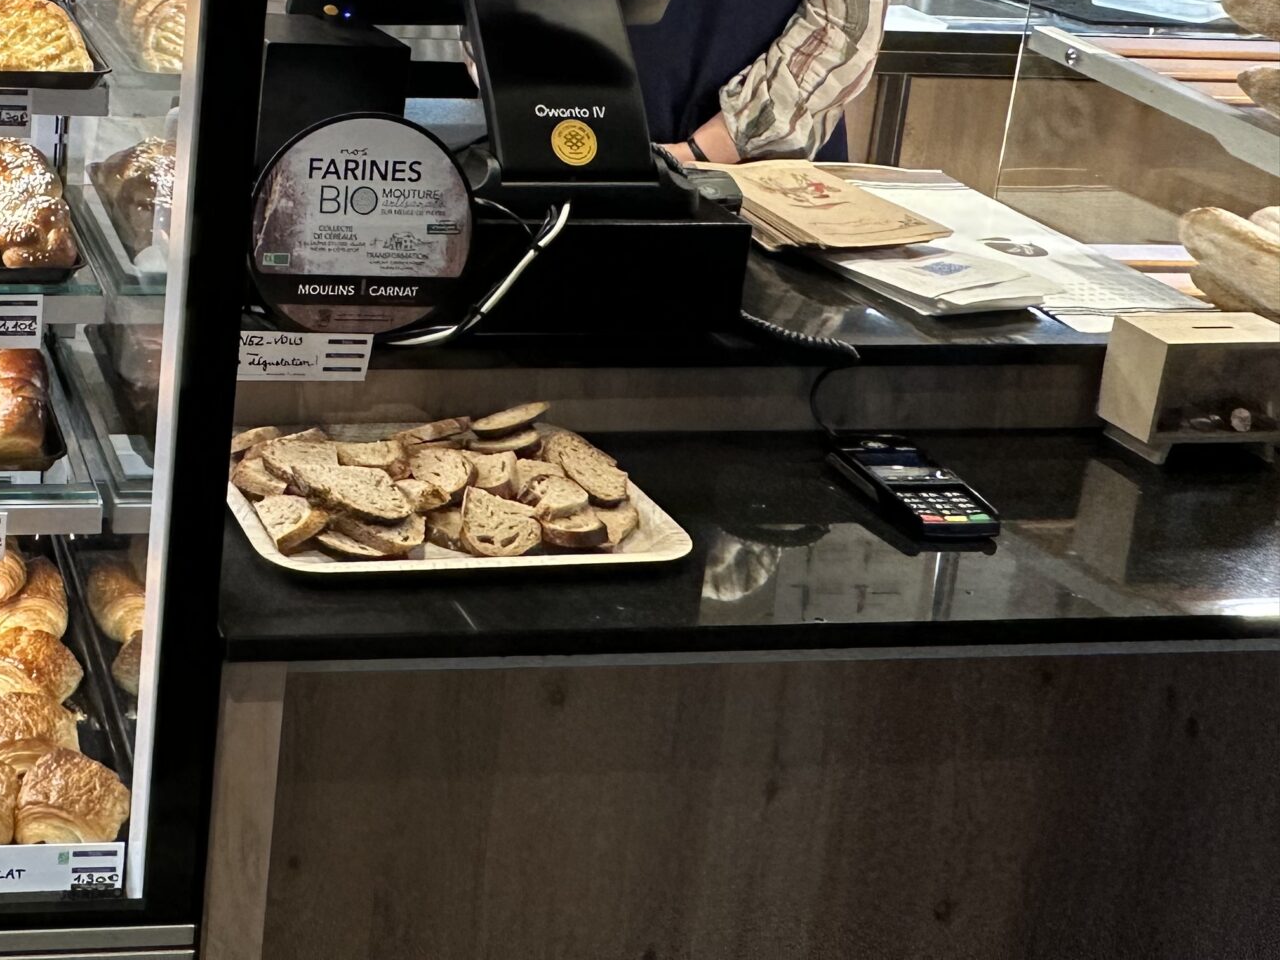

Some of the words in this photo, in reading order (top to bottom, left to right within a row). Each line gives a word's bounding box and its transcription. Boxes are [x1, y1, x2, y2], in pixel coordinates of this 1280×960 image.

[593, 106, 605, 118] IV
[308, 157, 423, 183] FARINES
[382, 188, 440, 200] MOUTURE
[319, 185, 379, 216] BIO
[297, 284, 355, 295] MOULINS
[369, 286, 419, 296] CARNAT
